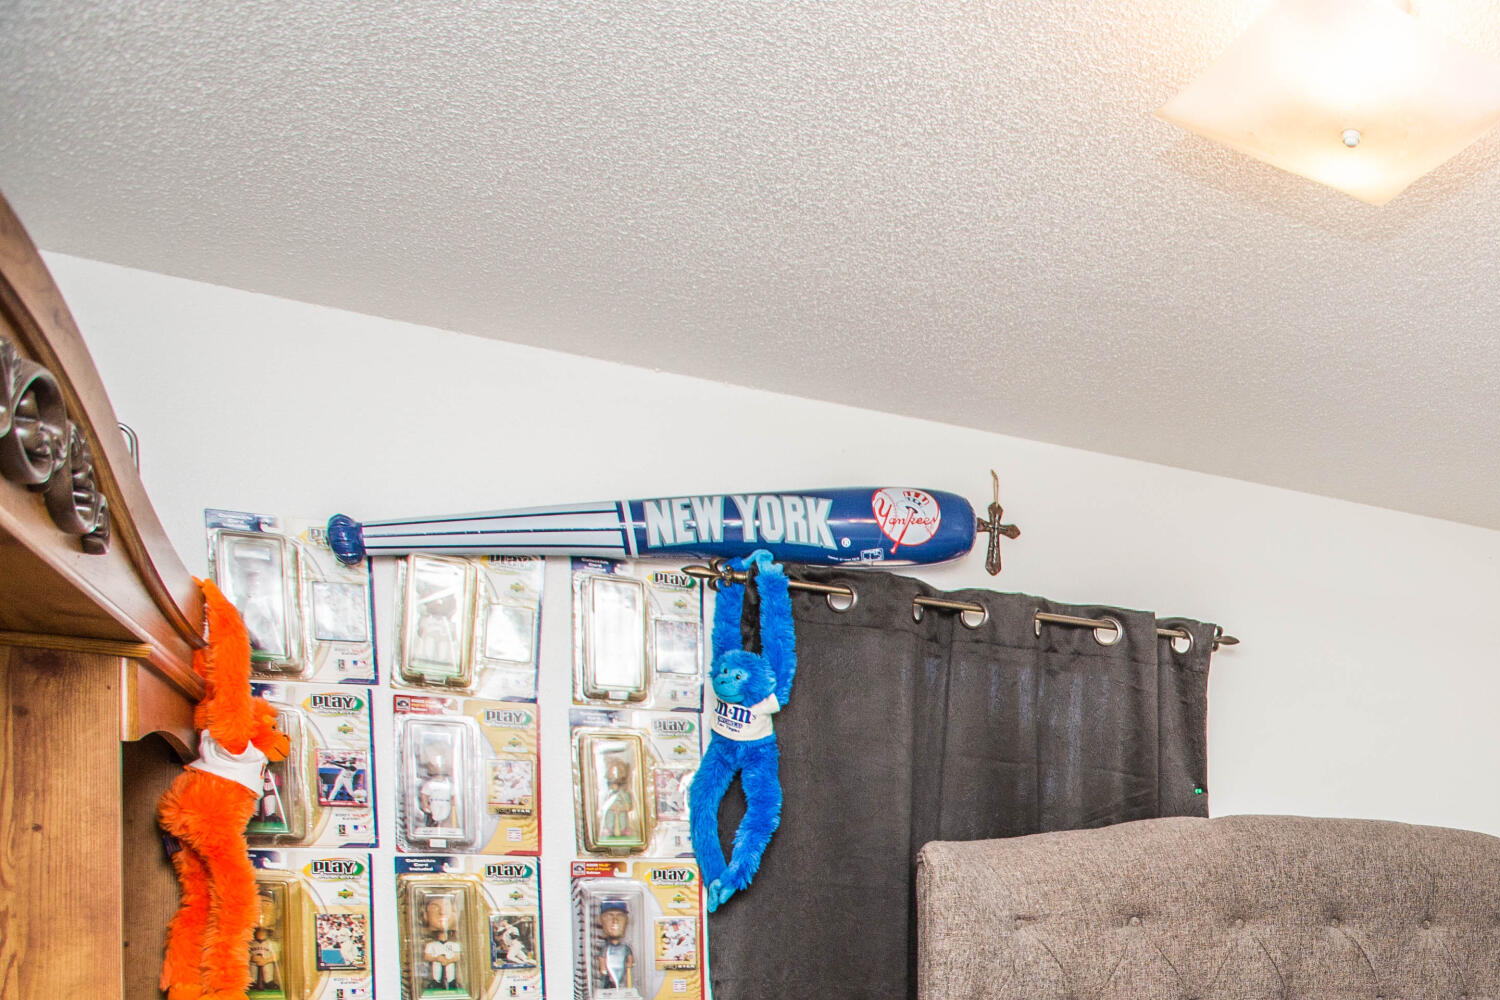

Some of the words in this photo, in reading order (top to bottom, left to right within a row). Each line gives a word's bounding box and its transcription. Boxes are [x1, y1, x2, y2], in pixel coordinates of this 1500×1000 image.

[643, 496, 725, 549] NEW
[730, 494, 838, 550] YORK
[873, 498, 937, 530] Yankees
